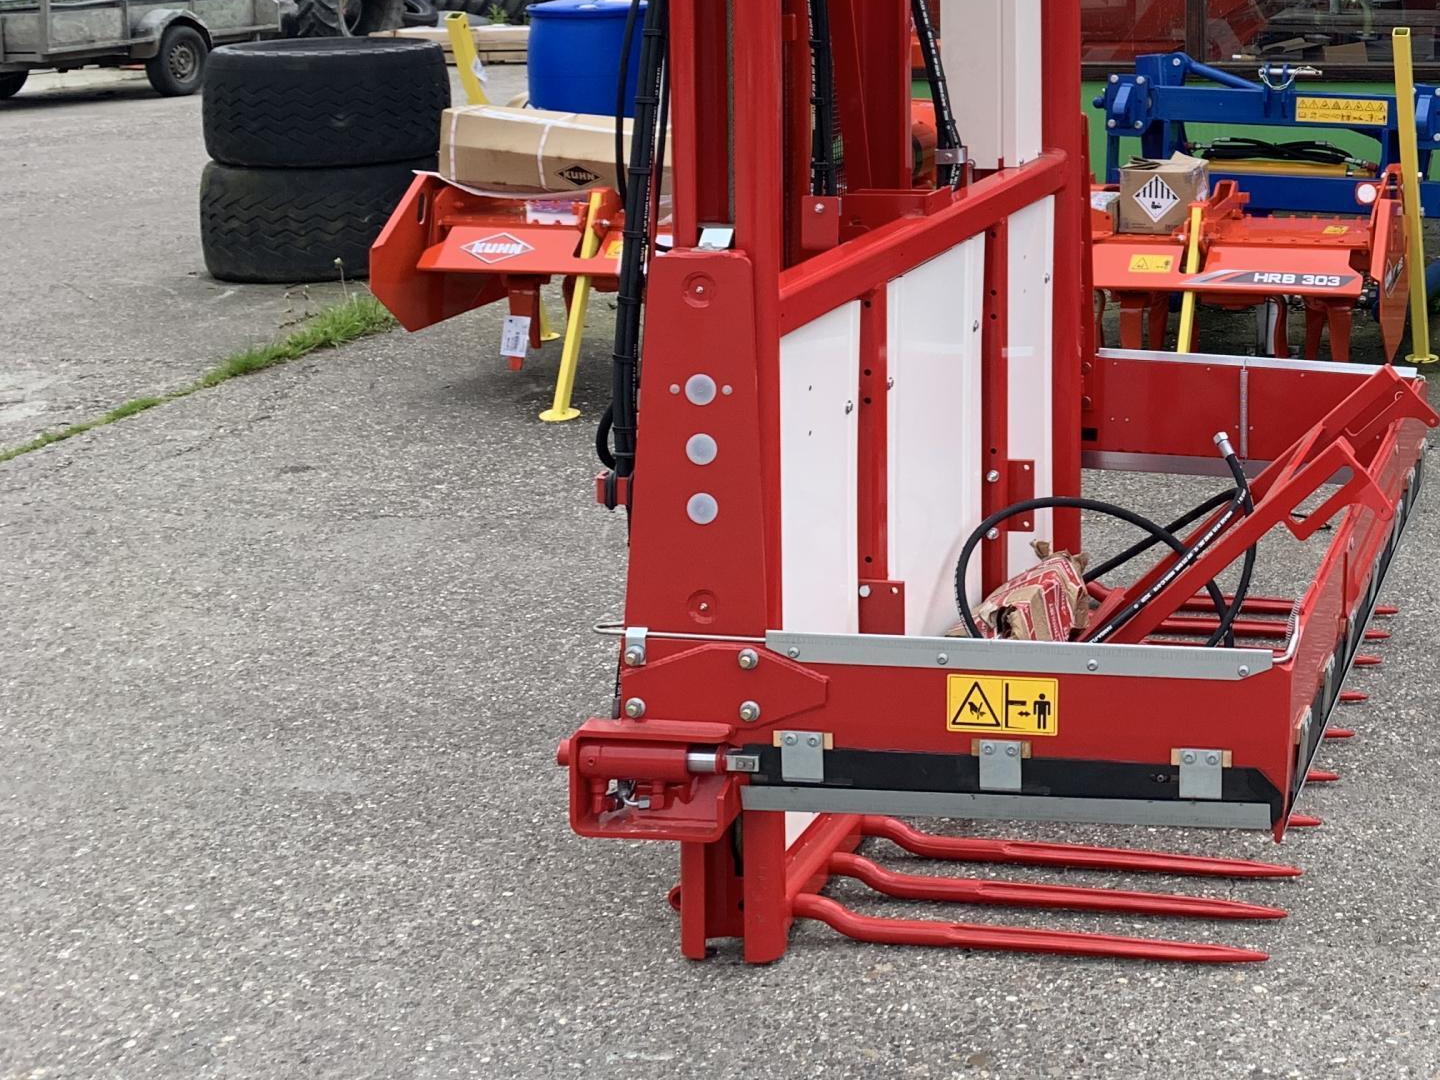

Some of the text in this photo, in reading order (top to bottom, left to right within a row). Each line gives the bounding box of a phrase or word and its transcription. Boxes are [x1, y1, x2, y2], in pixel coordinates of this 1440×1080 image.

[563, 170, 595, 181] KUHN
[471, 241, 524, 256] KUHN
[1253, 272, 1341, 287] HRB 303
